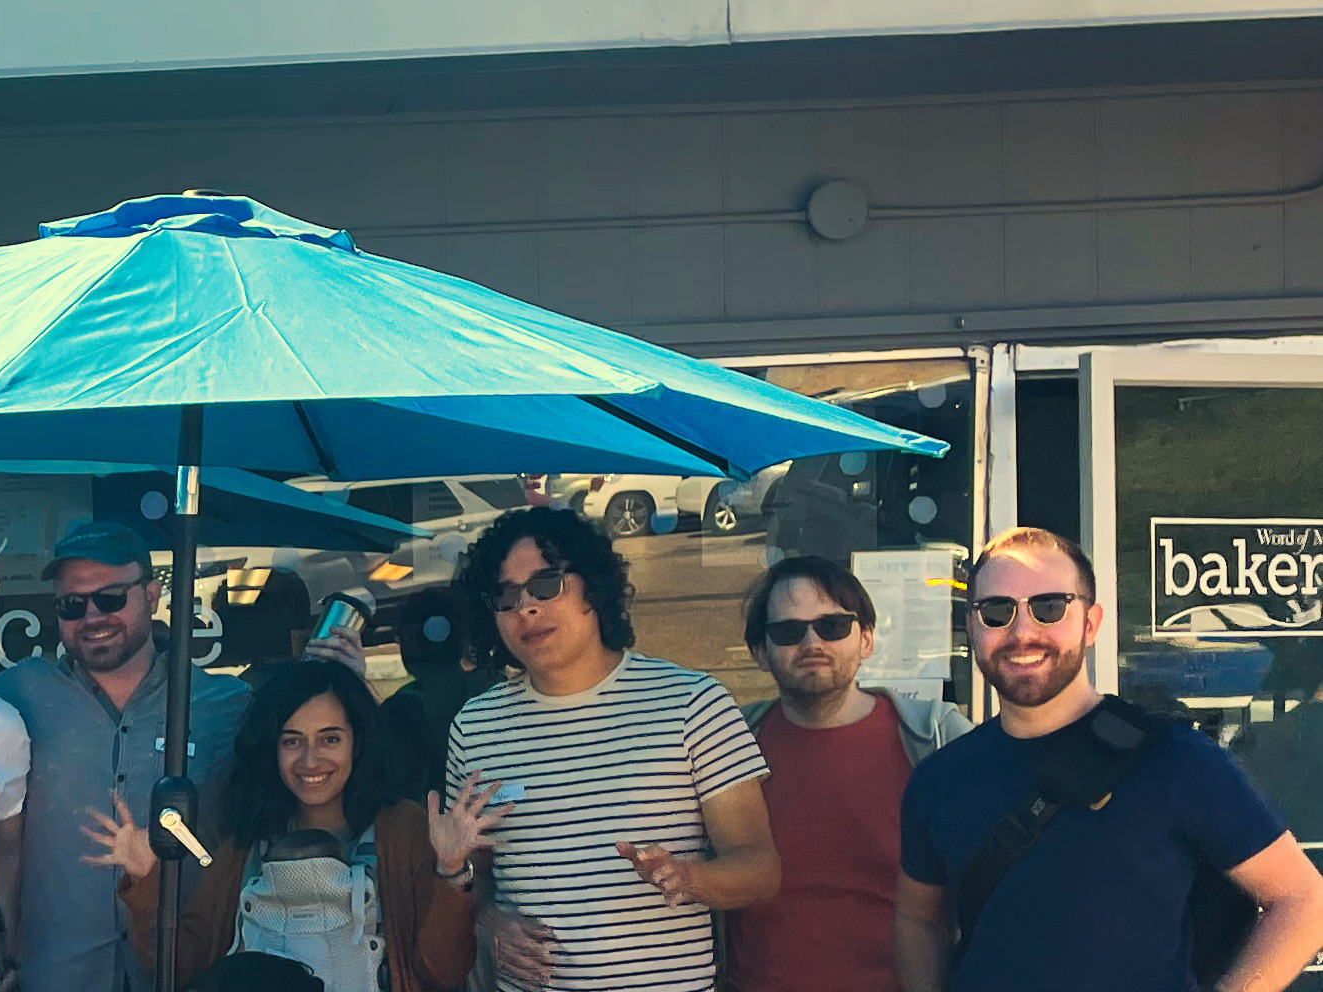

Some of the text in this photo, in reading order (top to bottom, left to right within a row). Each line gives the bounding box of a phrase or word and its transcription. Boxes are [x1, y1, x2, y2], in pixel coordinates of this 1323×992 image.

[1256, 528, 1295, 547] Word
[1296, 528, 1311, 555] of
[1159, 538, 1323, 597] baker
